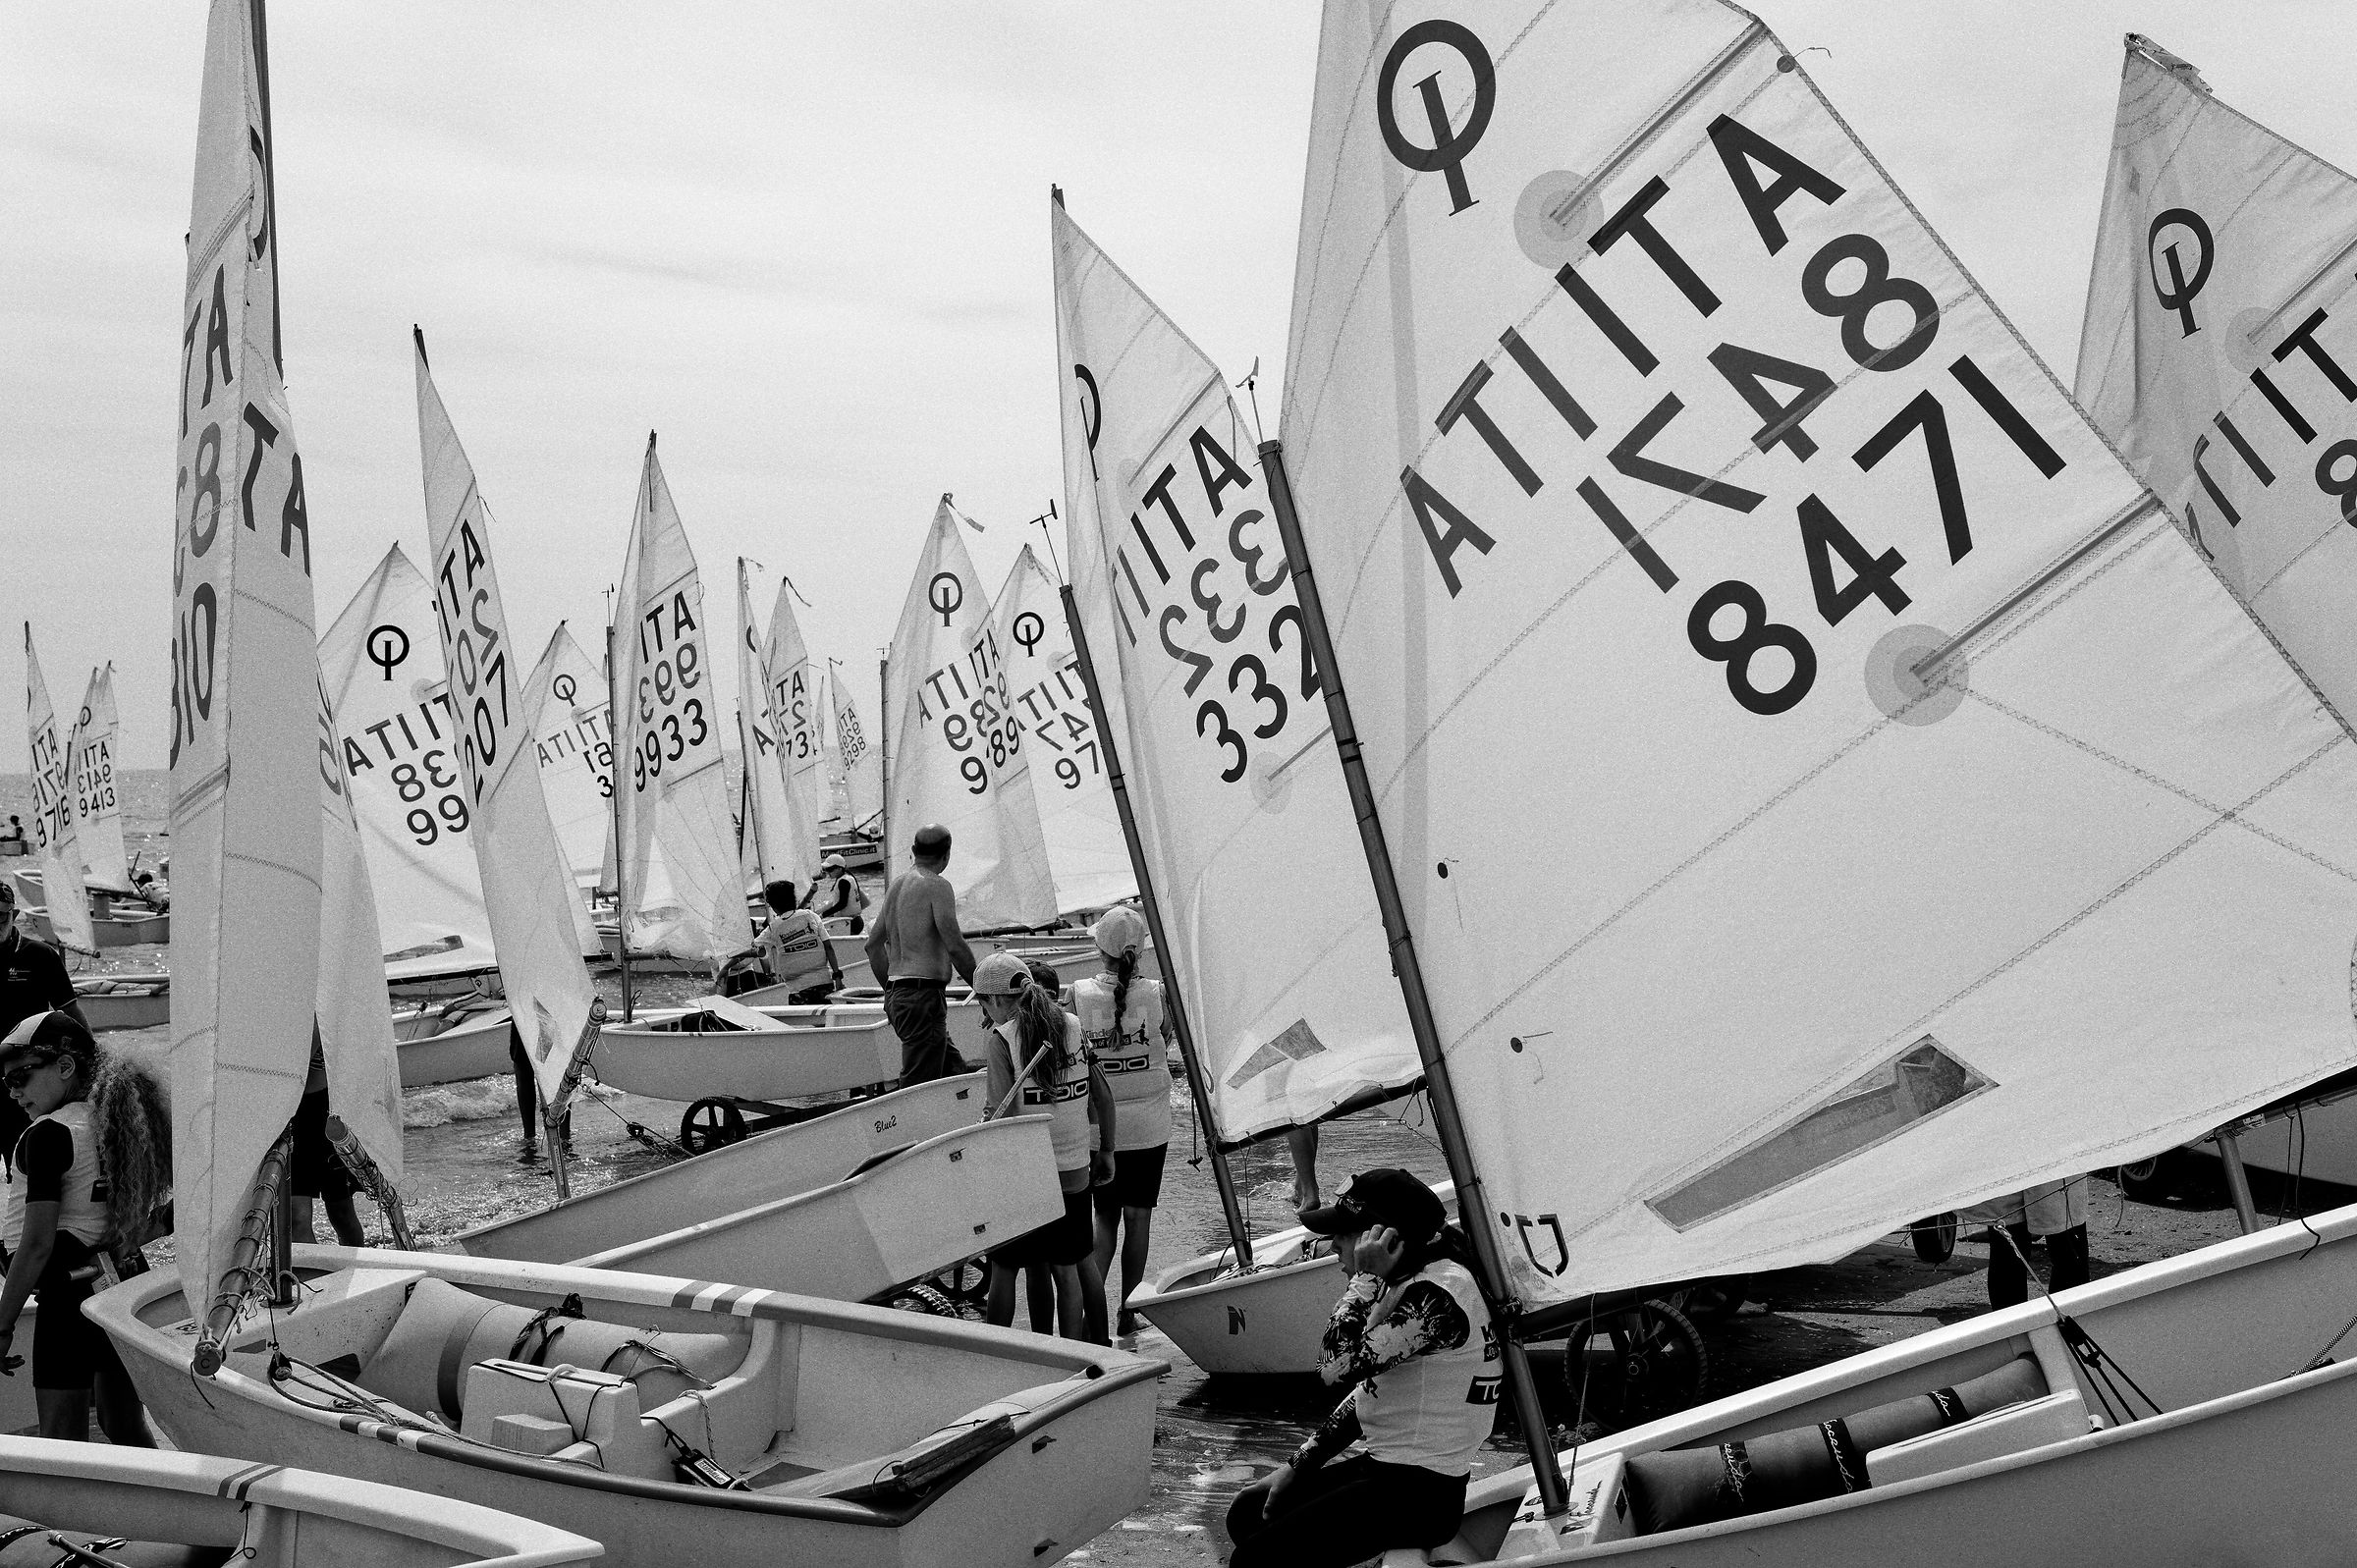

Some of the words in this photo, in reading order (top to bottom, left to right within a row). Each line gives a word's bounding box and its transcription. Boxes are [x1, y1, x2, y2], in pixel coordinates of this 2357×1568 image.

[1555, 113, 1846, 378] ITA
[1130, 425, 1253, 586] ITA
[1686, 354, 2067, 716] 8471
[438, 518, 485, 645] ITA
[640, 590, 696, 664] ITA
[465, 650, 509, 808] 207
[839, 708, 855, 731] ITA
[1196, 605, 1321, 783] 332
[31, 728, 58, 772] ITA
[84, 740, 109, 768] ITA
[634, 698, 707, 792] 9933
[35, 794, 71, 848] 9716
[79, 786, 115, 818] 9413
[874, 1115, 898, 1133] Blue2
